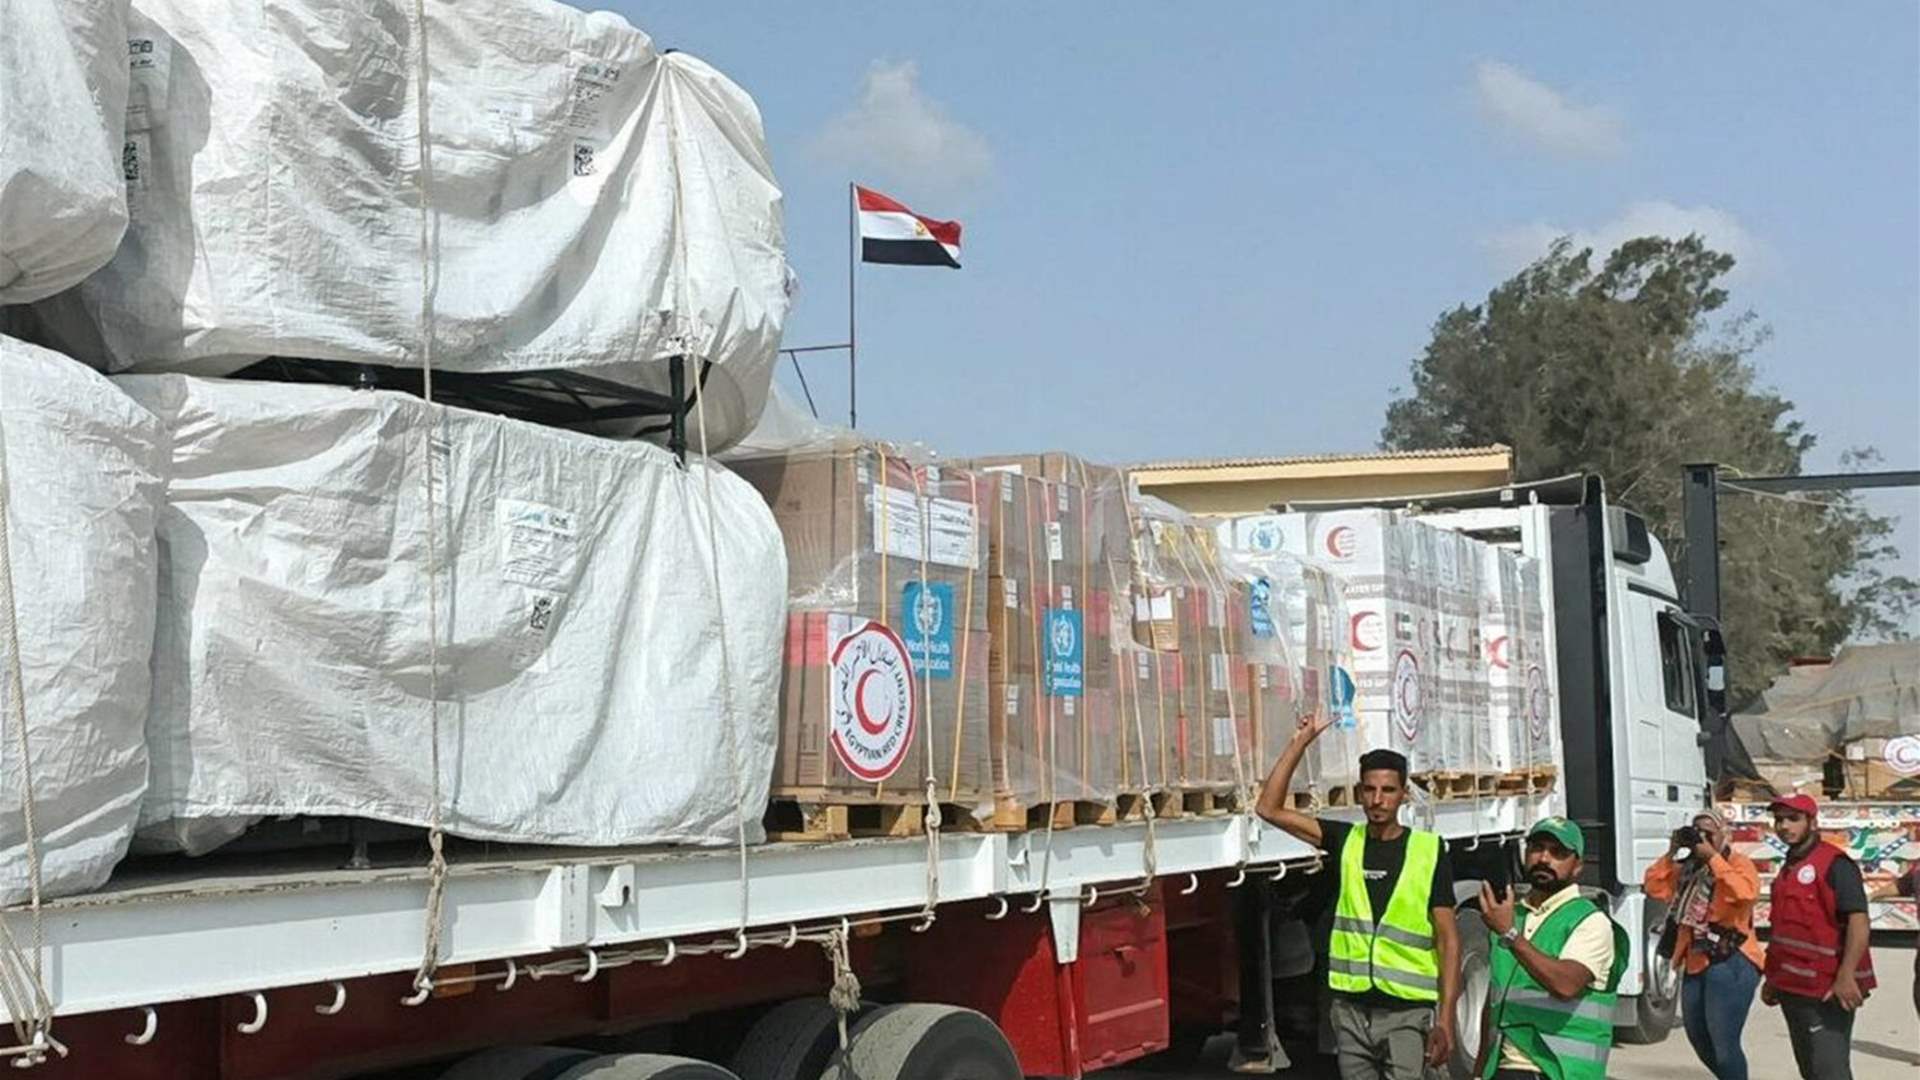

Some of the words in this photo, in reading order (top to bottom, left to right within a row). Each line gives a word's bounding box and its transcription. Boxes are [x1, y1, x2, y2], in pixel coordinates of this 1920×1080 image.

[845, 728, 882, 760] EGYPTIAN
[882, 736, 897, 756] RED
[894, 670, 906, 737] CRESCENT
